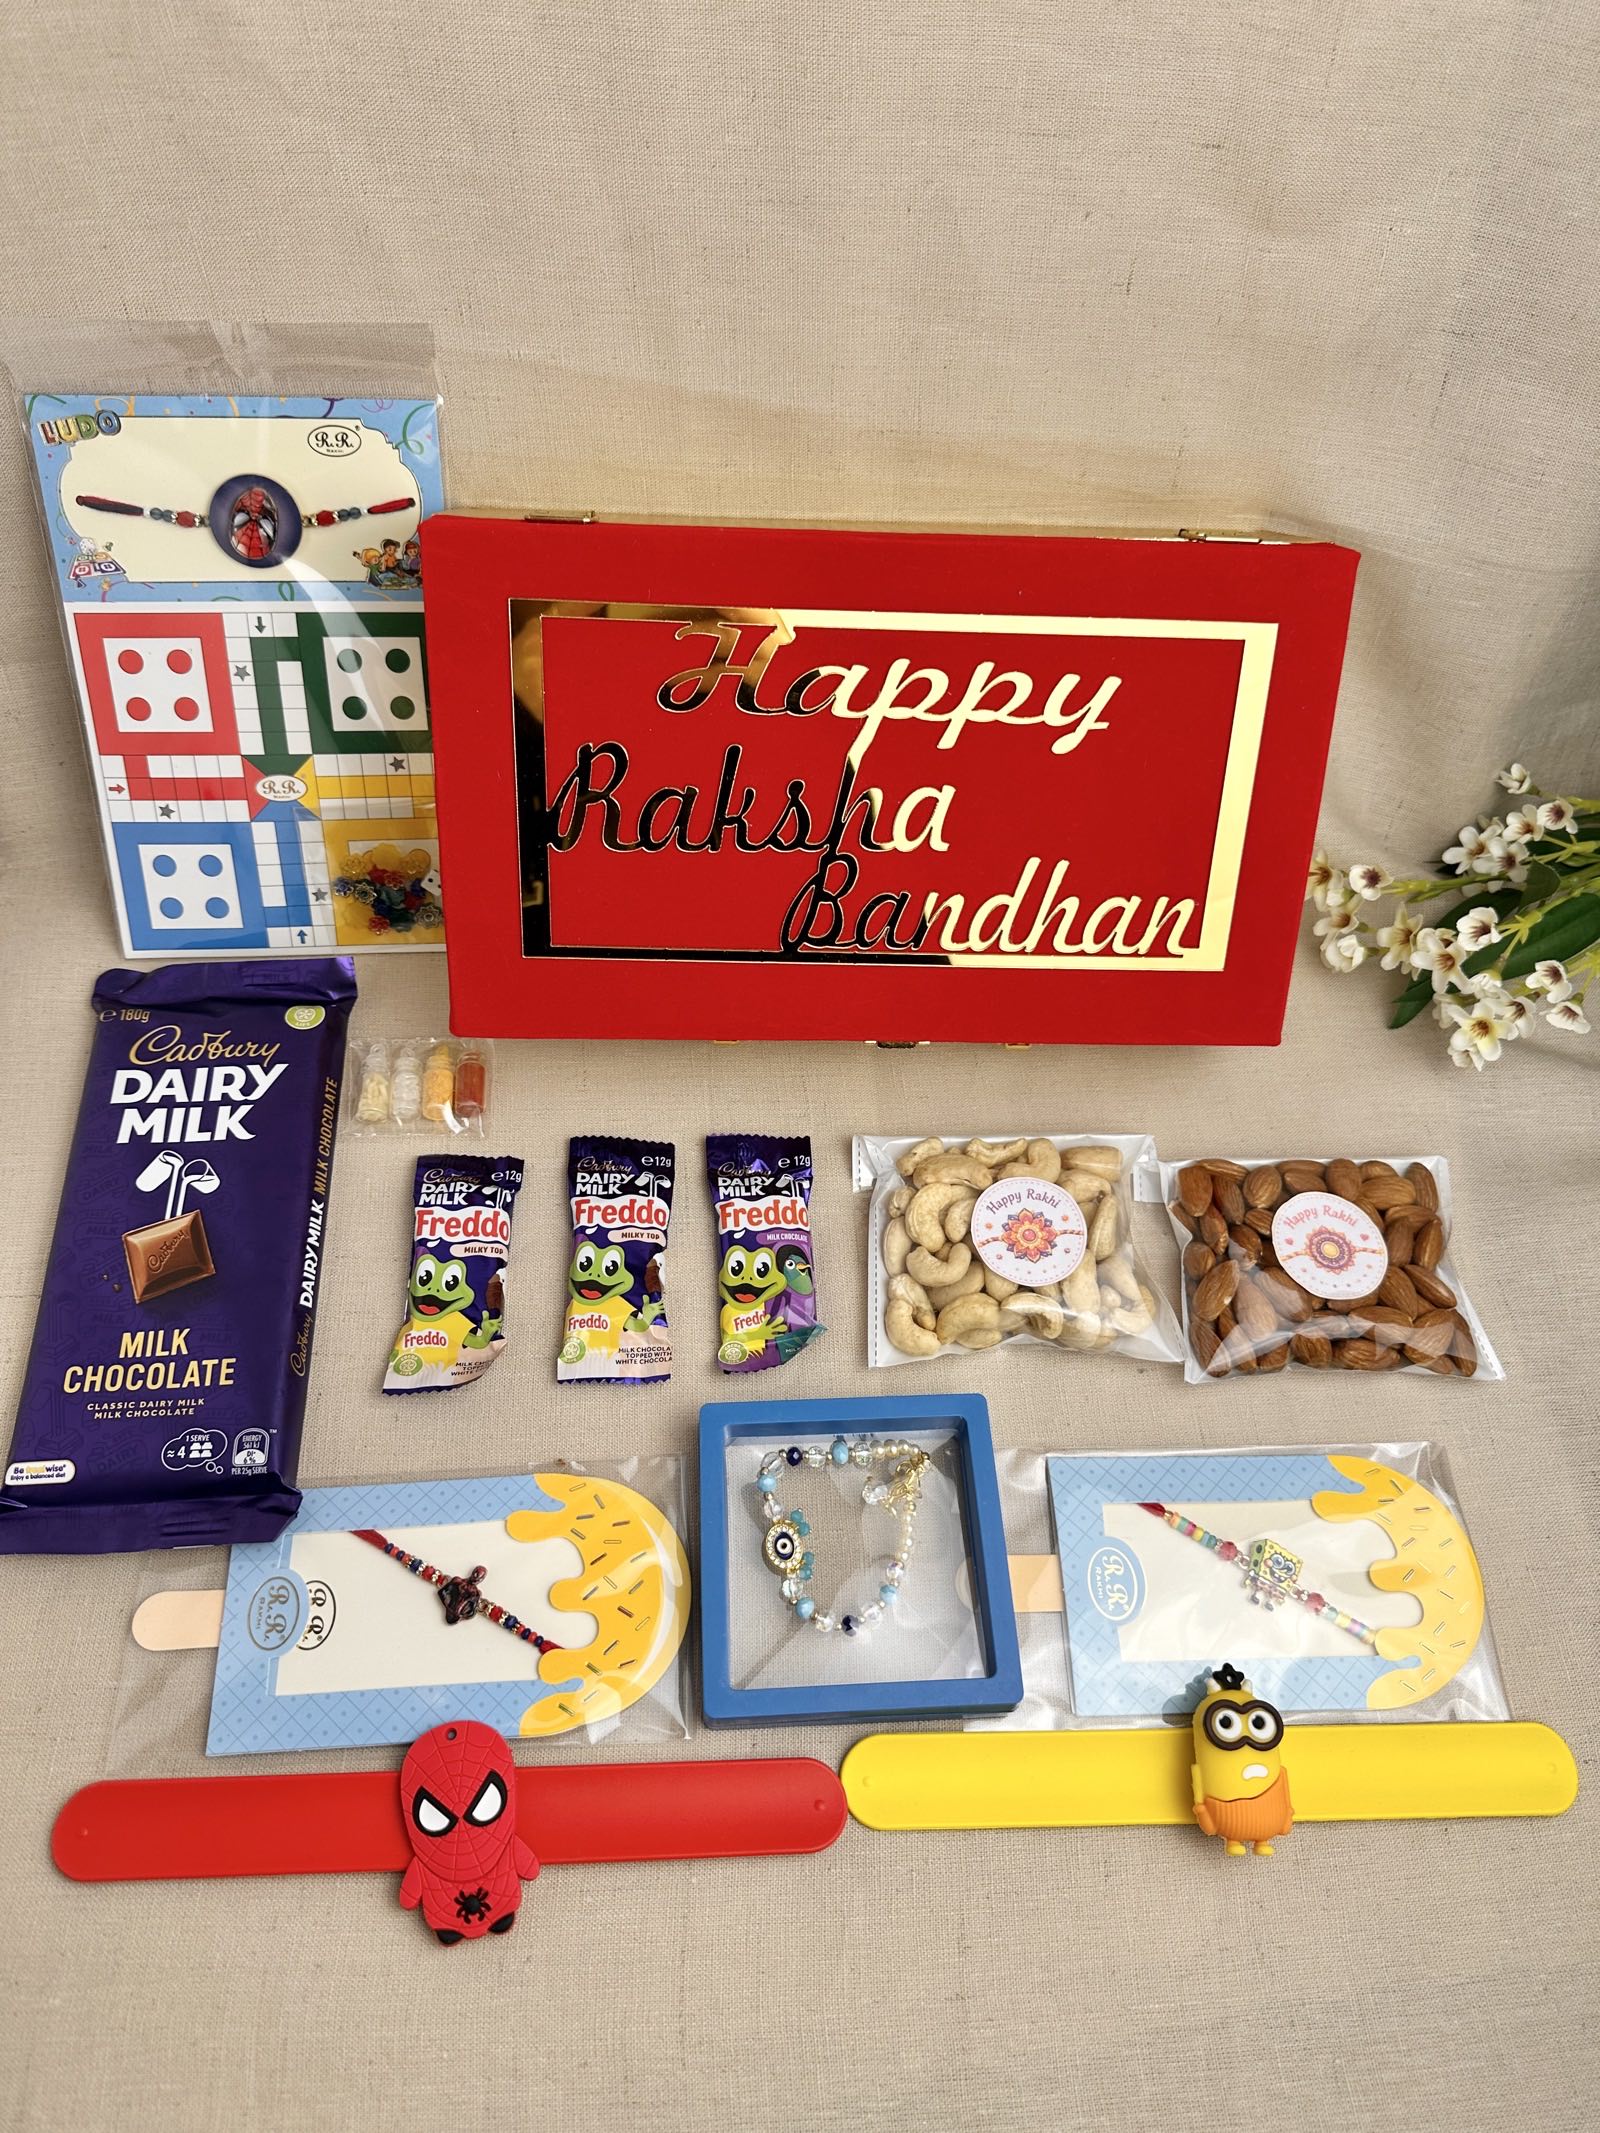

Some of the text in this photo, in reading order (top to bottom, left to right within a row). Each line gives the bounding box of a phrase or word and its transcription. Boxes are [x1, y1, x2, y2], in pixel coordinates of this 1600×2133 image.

[38, 410, 121, 446] LUDO
[657, 621, 1122, 754] Happy
[546, 740, 956, 854] Raksha
[781, 853, 1197, 957] Bandhan
[119, 1009, 150, 1023] 180g
[128, 1025, 281, 1067] Cadbury
[110, 1063, 289, 1104] DAIRY
[116, 1104, 257, 1144] MILK
[313, 1076, 338, 1196] MILK CHOCOLATE
[577, 1156, 632, 1173] Cadbury
[655, 1156, 672, 1167] 12g
[794, 1155, 811, 1167] 12g
[505, 1170, 522, 1183] 12g
[576, 1172, 635, 1185] DAIRY
[718, 1176, 775, 1187] DAIRY
[421, 1182, 481, 1194] DAIRY
[575, 1183, 623, 1195] MILK
[719, 1185, 766, 1200] MILK
[418, 1193, 469, 1206] MILK
[986, 1188, 1062, 1215] Happy Rakhi
[575, 1199, 667, 1227] Freddo
[720, 1199, 809, 1230] Freddo
[1283, 1204, 1360, 1230] Happy Rakhi
[416, 1210, 509, 1242] Freddo
[621, 1232, 645, 1240] MILKY
[766, 1233, 808, 1242] MILK CHOCOLATE
[291, 1199, 325, 1377] Cadbury DAIRY MILK
[568, 1315, 608, 1331] Freddo
[118, 1328, 191, 1359] MILK
[404, 1331, 447, 1349] Freddo
[625, 1351, 653, 1359] TOPPED
[63, 1358, 237, 1394] CHOCOLATE
[87, 1398, 205, 1411] CLASSIC DAIRY MILK
[94, 1407, 195, 1420] MILK CHOCOLATE
[191, 1434, 210, 1442] SERVE
[177, 1446, 186, 1459] 4
[242, 1467, 252, 1476] 25g
[252, 1466, 268, 1474] SERVE
[1095, 1566, 1104, 1600] RAKHI
